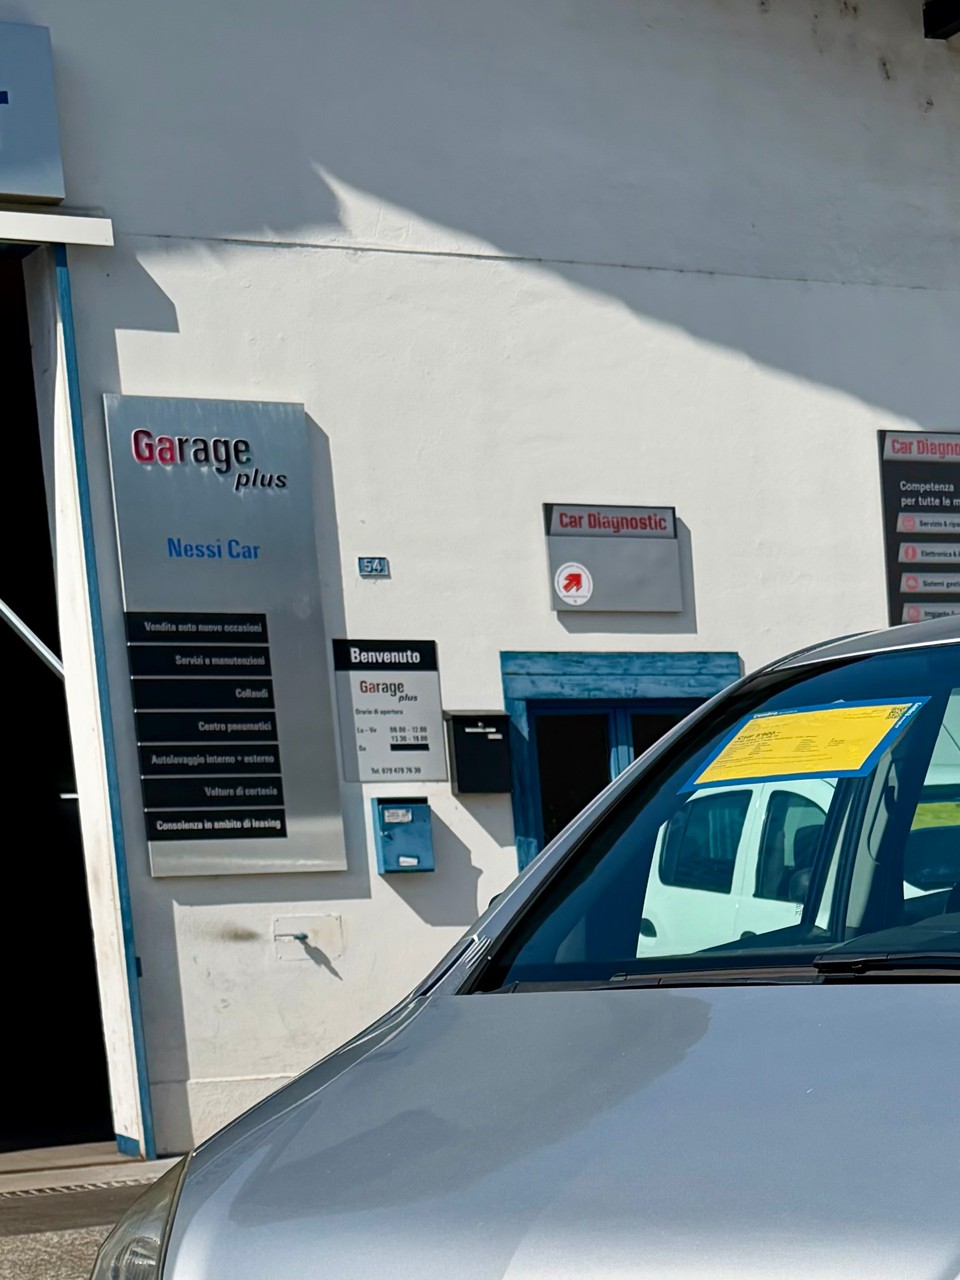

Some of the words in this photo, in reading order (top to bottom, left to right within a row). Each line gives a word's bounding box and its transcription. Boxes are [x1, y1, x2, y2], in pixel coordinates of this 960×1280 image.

[131, 428, 251, 474] Garage
[891, 438, 913, 454] Car
[234, 468, 288, 492] plus
[899, 481, 954, 493] Competenza
[901, 497, 915, 507] per
[918, 496, 940, 506] tutte
[942, 496, 951, 506] le
[559, 512, 584, 529] Car
[587, 512, 667, 533] Diagnostic
[919, 520, 942, 528] Servizio
[167, 537, 222, 558] Nessi
[227, 539, 261, 559] Car
[921, 550, 952, 558] Elettronica
[363, 558, 383, 574] 54
[922, 580, 944, 588] Sistemi
[144, 621, 176, 632] Vendita
[178, 623, 197, 632] auto
[198, 623, 223, 632] nuove
[224, 622, 262, 633] occasioni
[175, 655, 203, 666] Servizi
[205, 657, 211, 666] e
[211, 656, 266, 666] manutenzioni
[349, 646, 421, 664] Benvenuto
[235, 688, 269, 698] Collaudi
[360, 680, 405, 697] Garage
[398, 694, 418, 703] plus
[198, 721, 226, 731] Centro
[227, 721, 272, 733] pneumatici
[151, 754, 205, 766] Autolavaggio
[206, 754, 236, 764] interno
[244, 754, 275, 764] esterno
[236, 786, 244, 796] di
[245, 786, 278, 796] cortesia
[204, 819, 213, 829] in
[213, 819, 242, 829] ambito
[243, 819, 251, 829] di
[252, 818, 281, 830] leasing
